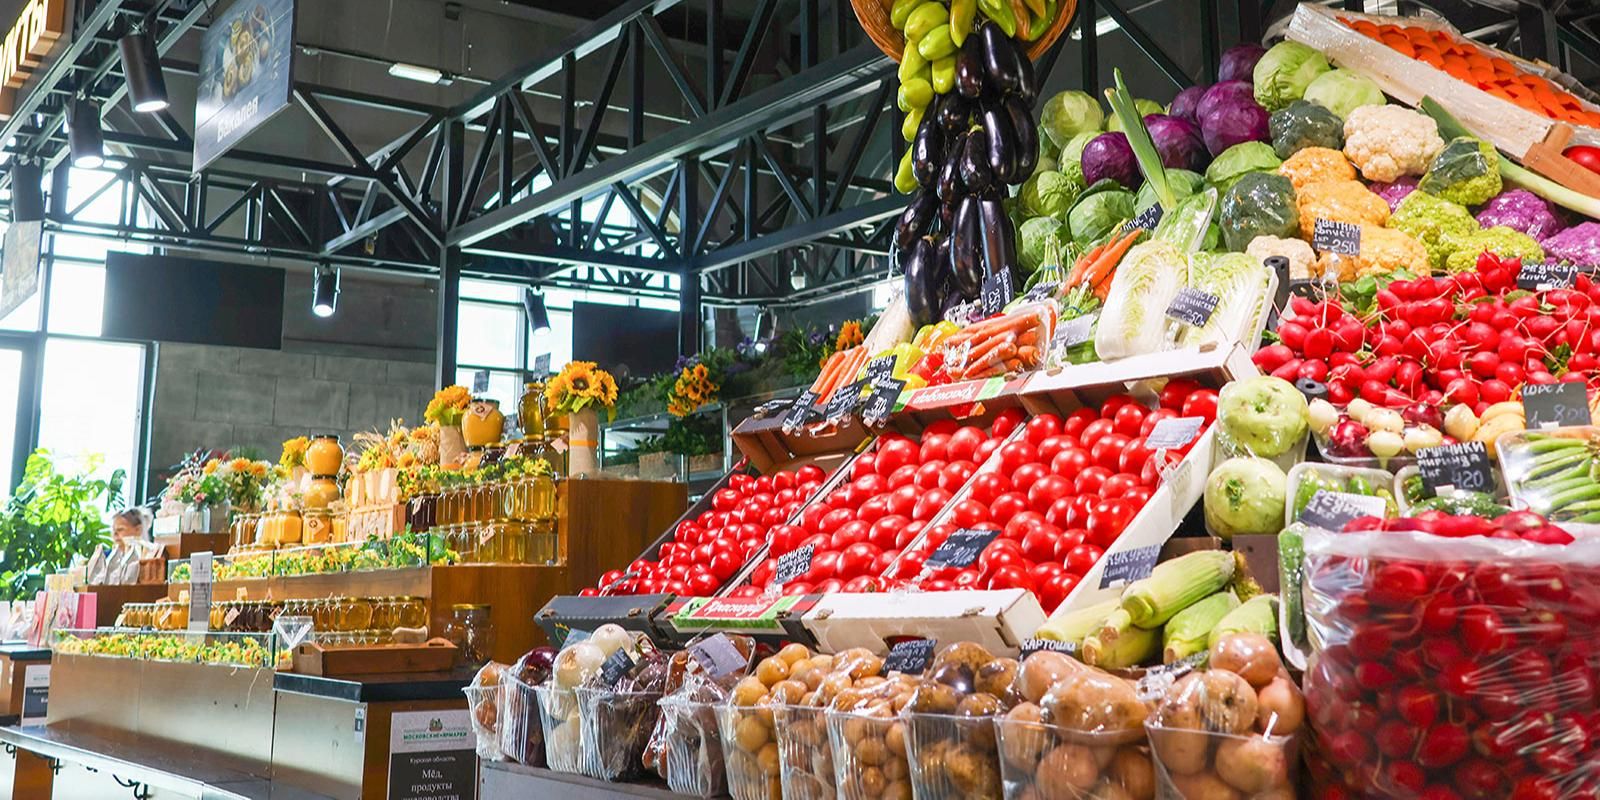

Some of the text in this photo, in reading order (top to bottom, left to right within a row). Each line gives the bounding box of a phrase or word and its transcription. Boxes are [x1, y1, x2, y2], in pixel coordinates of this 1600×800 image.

[0, 0, 48, 94] КТЫ
[217, 95, 259, 143] Бакалея
[1416, 441, 1485, 459] ОГУРЧИКИ
[411, 782, 453, 794] продукты
